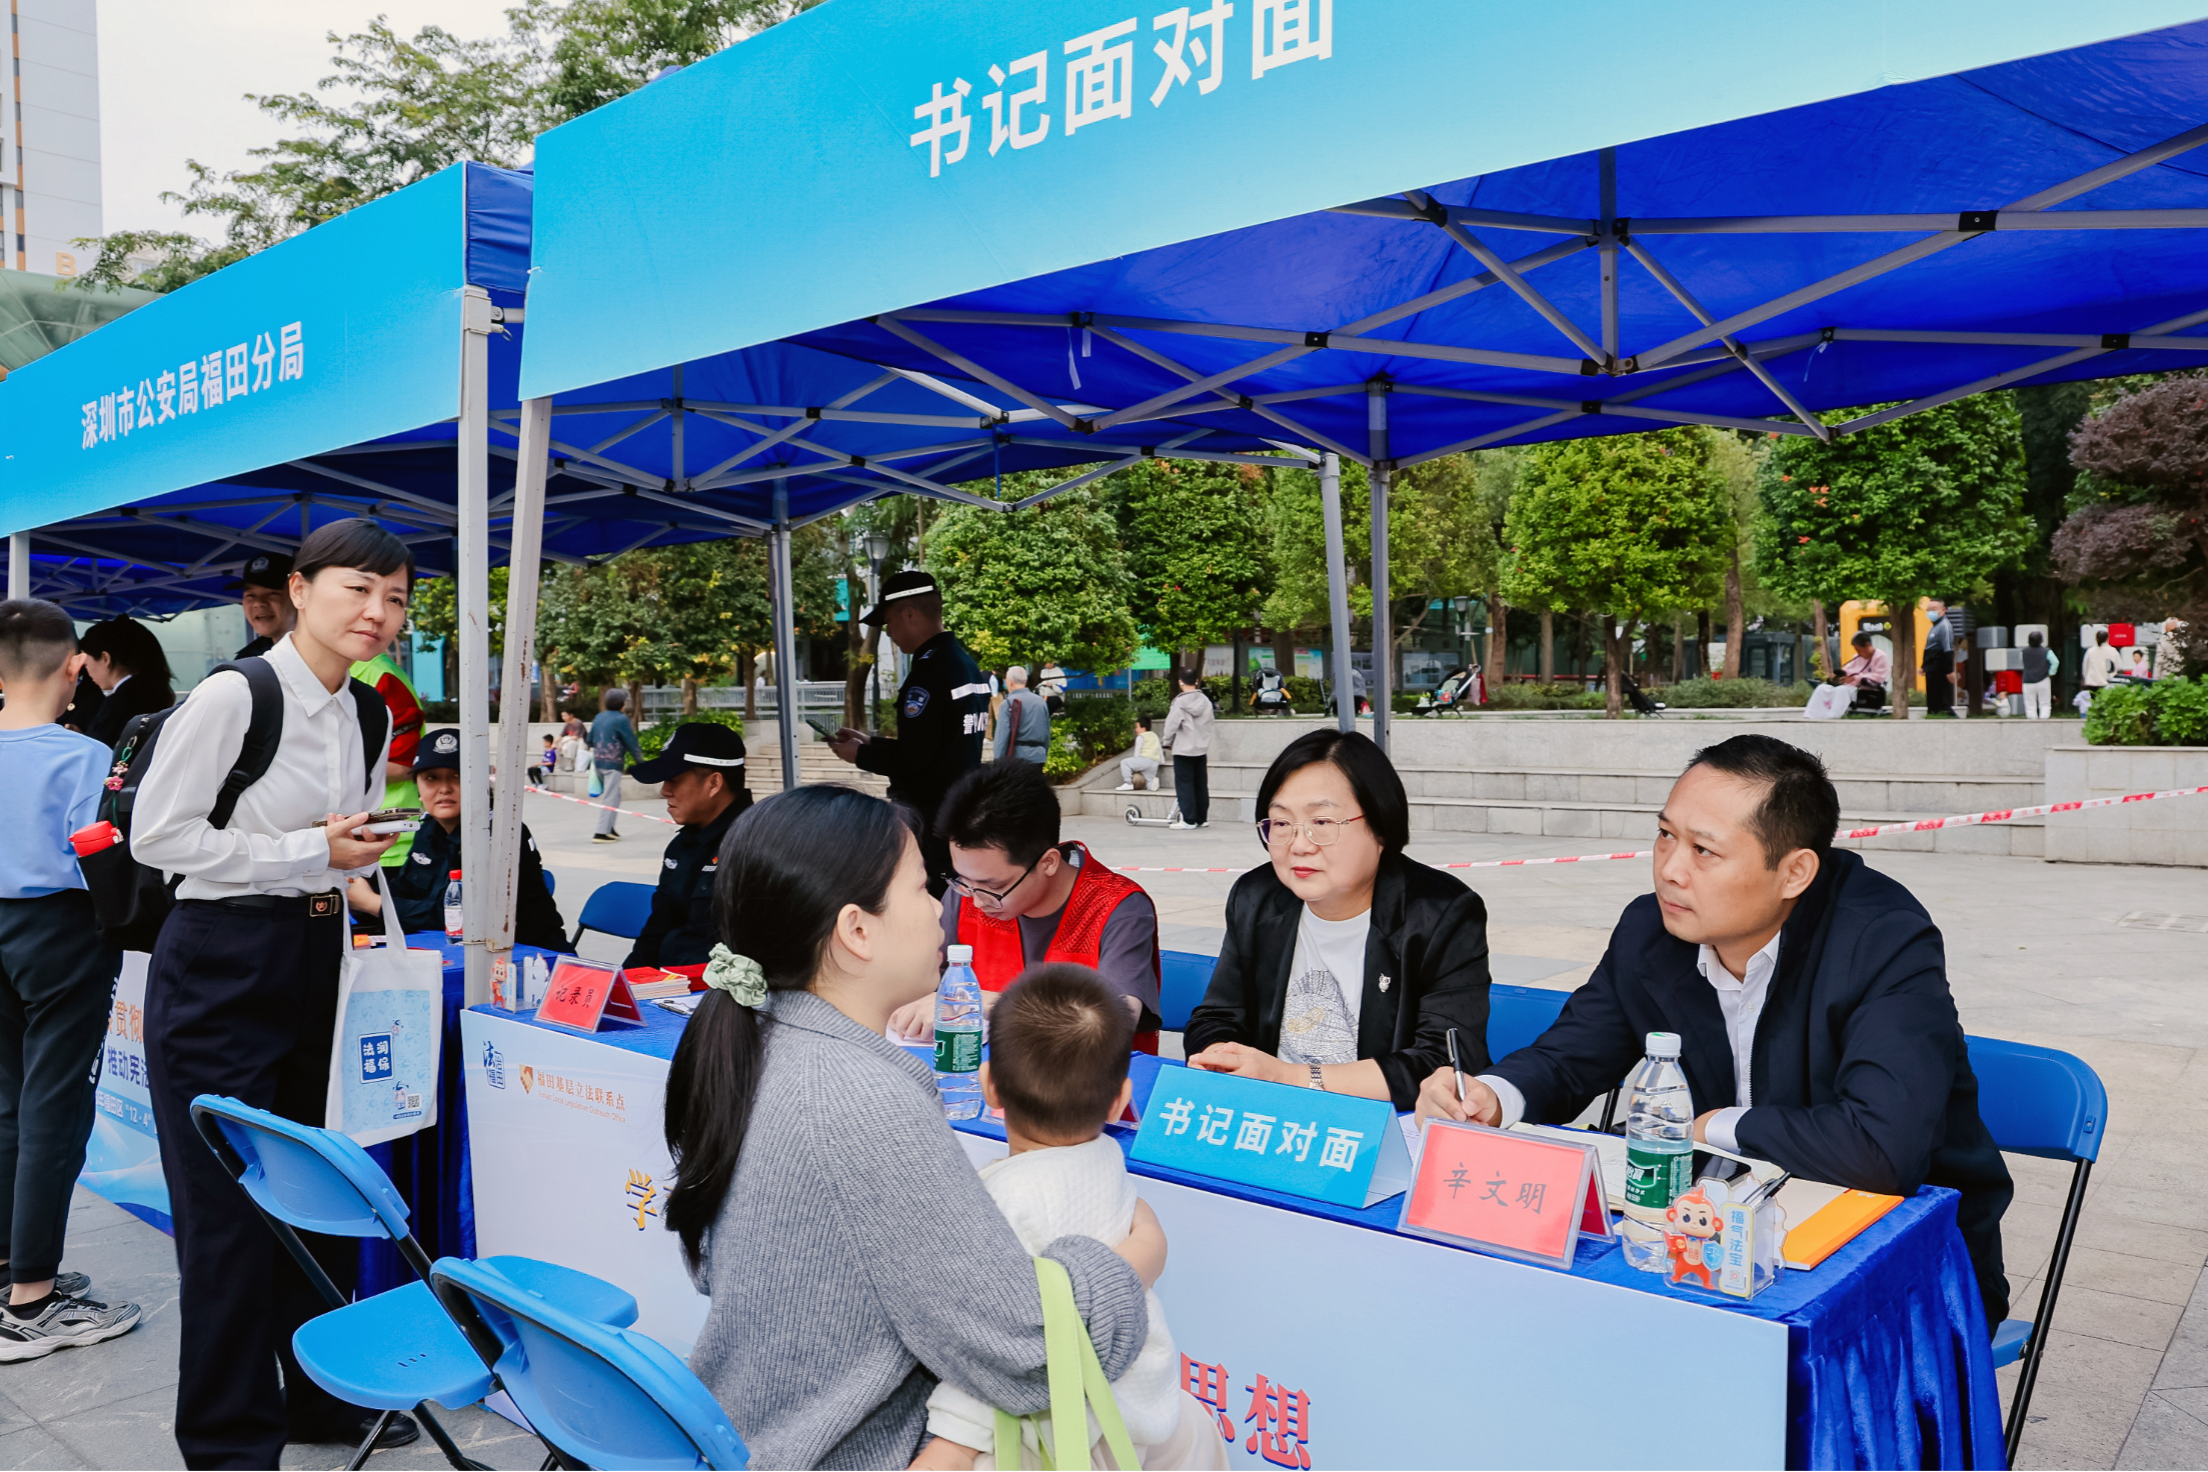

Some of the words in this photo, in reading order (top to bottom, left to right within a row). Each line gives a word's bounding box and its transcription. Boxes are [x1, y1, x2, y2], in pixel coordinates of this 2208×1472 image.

[910, 0, 1332, 178] 书记面对面
[56, 251, 77, 276] B
[81, 321, 304, 450] 深圳市公安局福田分局
[556, 985, 595, 1009] 记录员
[363, 1040, 389, 1056] 法润
[364, 1057, 390, 1074] 福保
[537, 1070, 625, 1111] 福田基层立法联系点
[1159, 1097, 1364, 1173] 书记面对面
[1443, 1162, 1547, 1215] 辛文明
[1729, 1210, 1744, 1267] 福气法宝
[1180, 1351, 1311, 1471] 思想
